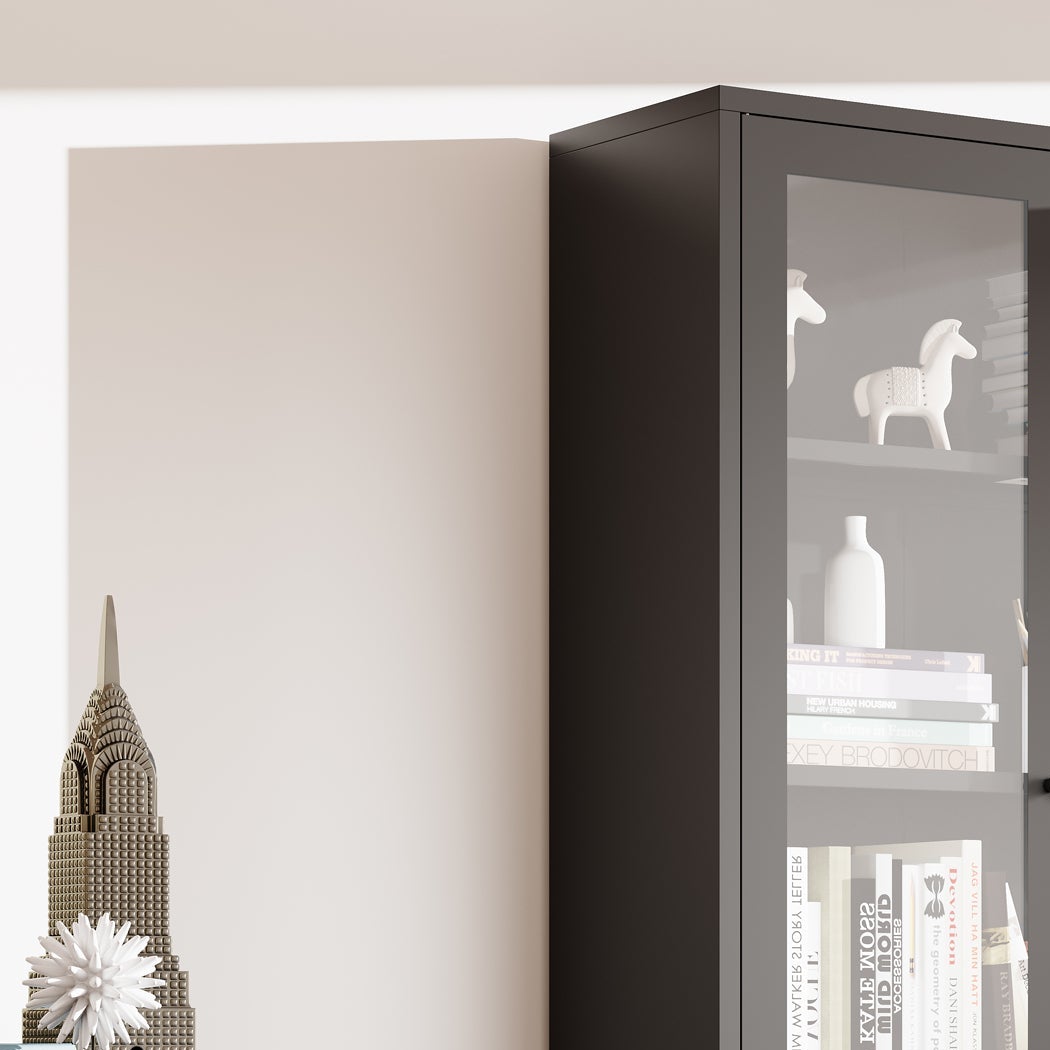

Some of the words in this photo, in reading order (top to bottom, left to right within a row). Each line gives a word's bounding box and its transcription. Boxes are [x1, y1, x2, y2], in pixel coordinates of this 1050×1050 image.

[824, 650, 840, 663] IT
[806, 697, 827, 707] NEW
[827, 698, 858, 708] URBAN
[858, 699, 897, 710] HOUSING
[806, 706, 829, 714] HILARY
[830, 707, 856, 715] FRENCH
[841, 745, 978, 771] BRODOVITCH
[970, 862, 979, 888] JAG
[948, 867, 958, 966] Devotion
[970, 892, 978, 920] VILL
[931, 925, 941, 946] the
[970, 924, 978, 942] HA
[970, 946, 978, 970] MIN
[929, 950, 941, 1016] geometry
[949, 977, 958, 1012] DANI
[970, 974, 978, 1007] HATT
[999, 971, 1011, 1000] RAY
[931, 1020, 942, 1034] of
